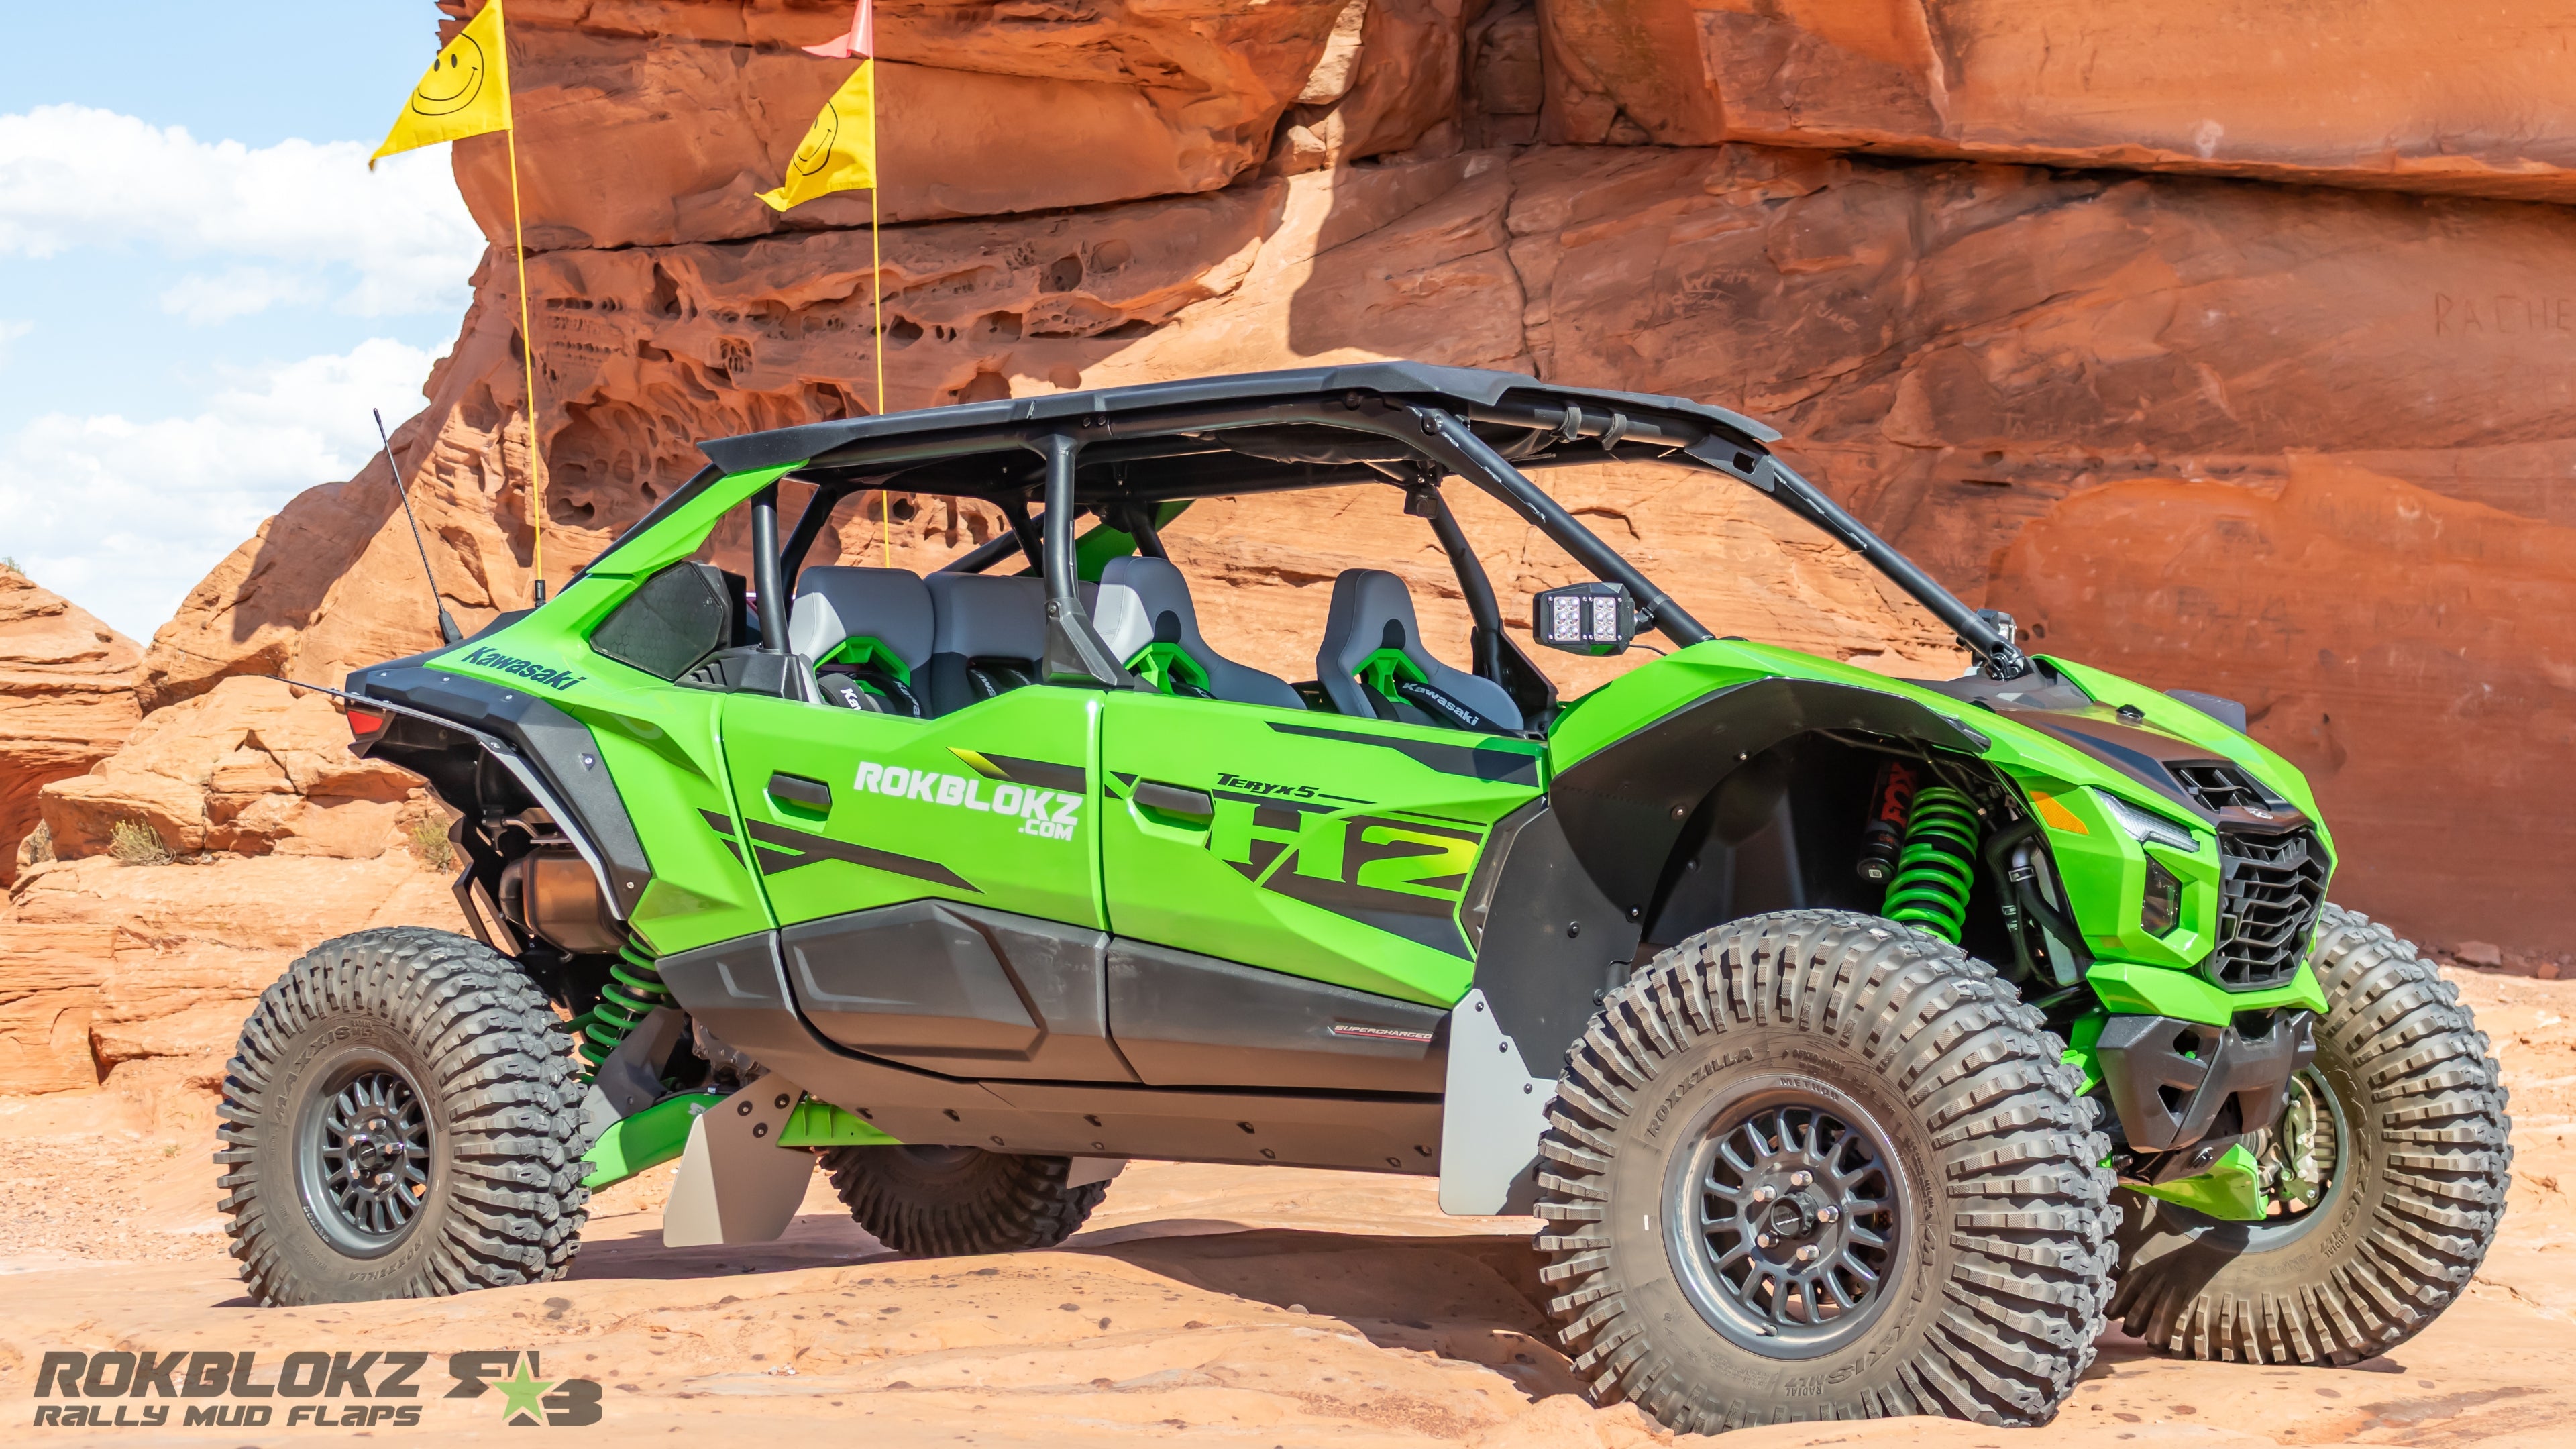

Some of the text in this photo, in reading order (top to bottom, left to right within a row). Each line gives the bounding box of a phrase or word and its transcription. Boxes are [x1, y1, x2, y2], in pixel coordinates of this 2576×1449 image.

[460, 646, 587, 691] Kawasaki
[1402, 682, 1479, 726] Kawasaki
[853, 761, 1083, 826] ROKBLOKZ
[1018, 819, 1074, 841] .COM
[1210, 798, 1479, 902] H2
[1334, 1025, 1434, 1039] SUPERCHARGED
[274, 1025, 351, 1124] MAXXIS
[1644, 1046, 1754, 1138] ROXXZILLA
[1780, 1077, 1839, 1102] METHOD
[2324, 1231, 2351, 1259] RADIAL
[1827, 1224, 1937, 1384] MAXXIS
[1785, 1375, 1827, 1388] ML7
[1786, 1385, 1823, 1397] RADIAL
